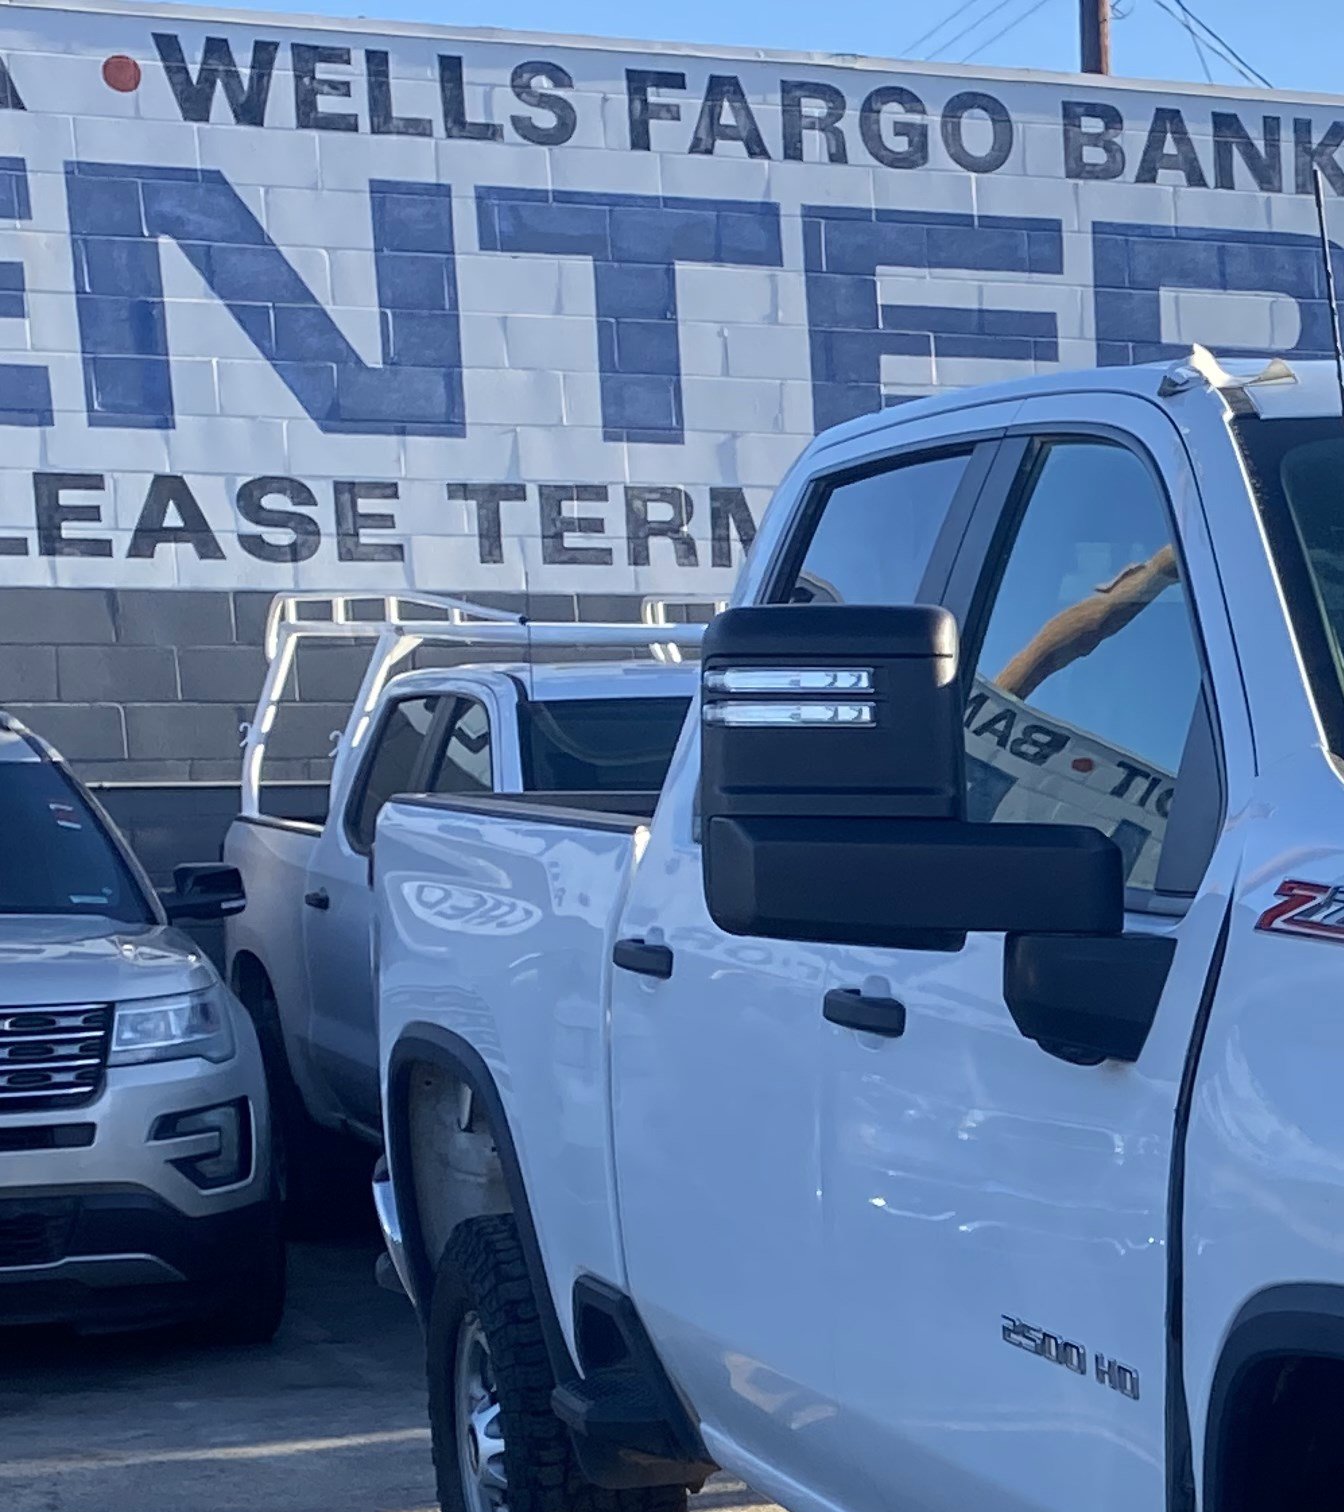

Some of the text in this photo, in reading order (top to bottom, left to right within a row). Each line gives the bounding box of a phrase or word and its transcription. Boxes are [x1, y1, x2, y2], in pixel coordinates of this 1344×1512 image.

[151, 31, 578, 147] WELLS
[624, 67, 1014, 174] FARGO
[1000, 1314, 1140, 1401] 2500 HD
